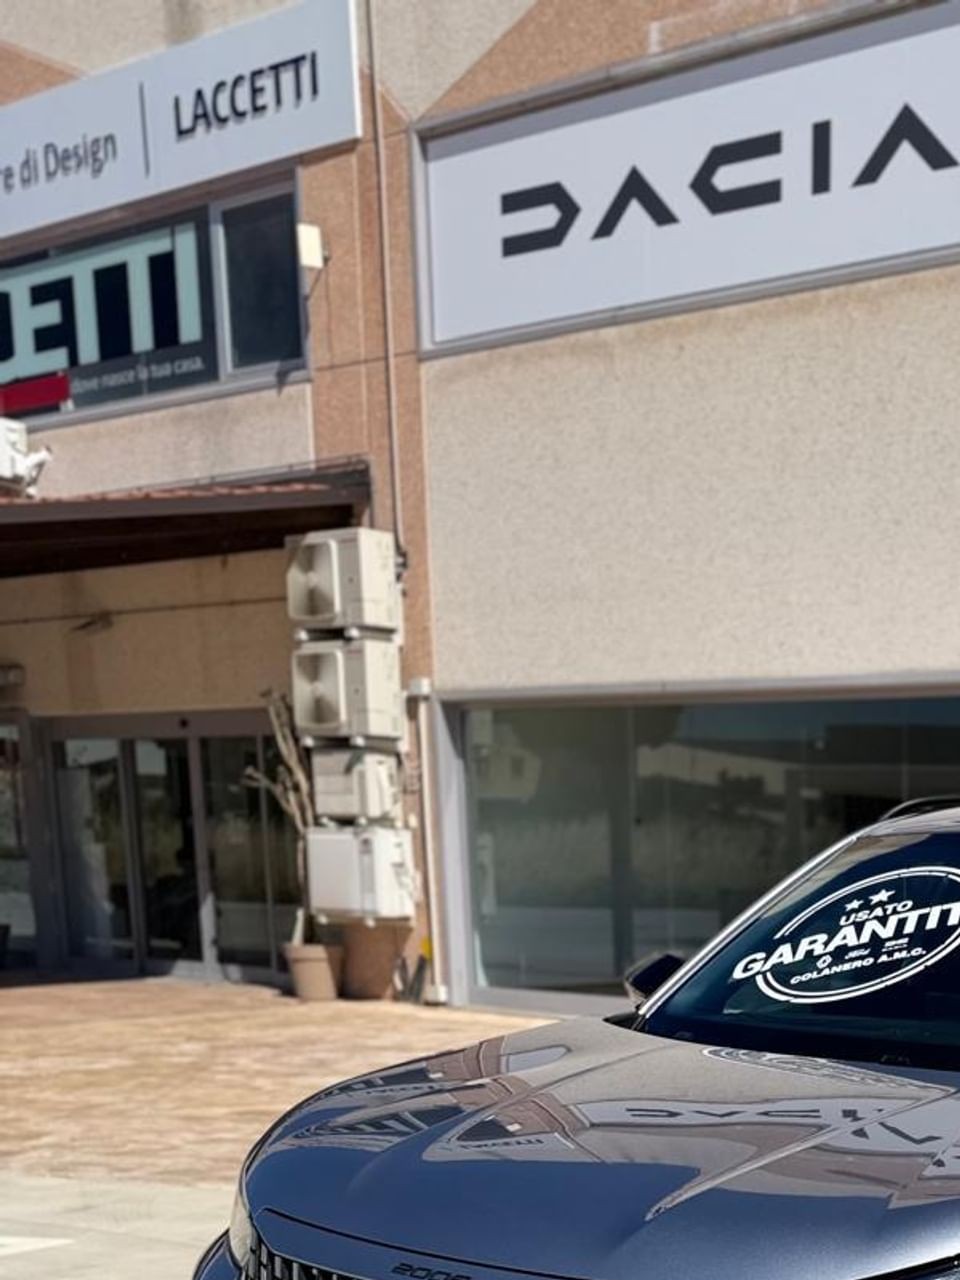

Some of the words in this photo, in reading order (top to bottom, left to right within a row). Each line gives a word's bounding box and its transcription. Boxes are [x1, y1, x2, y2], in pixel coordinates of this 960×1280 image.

[20, 148, 39, 189] di
[44, 133, 117, 180] Design
[174, 51, 319, 141] LACCETTI
[500, 102, 960, 258] DACIA
[839, 900, 913, 926] USATO
[790, 957, 875, 984] COLANERO
[877, 947, 927, 963] A.M.C.
